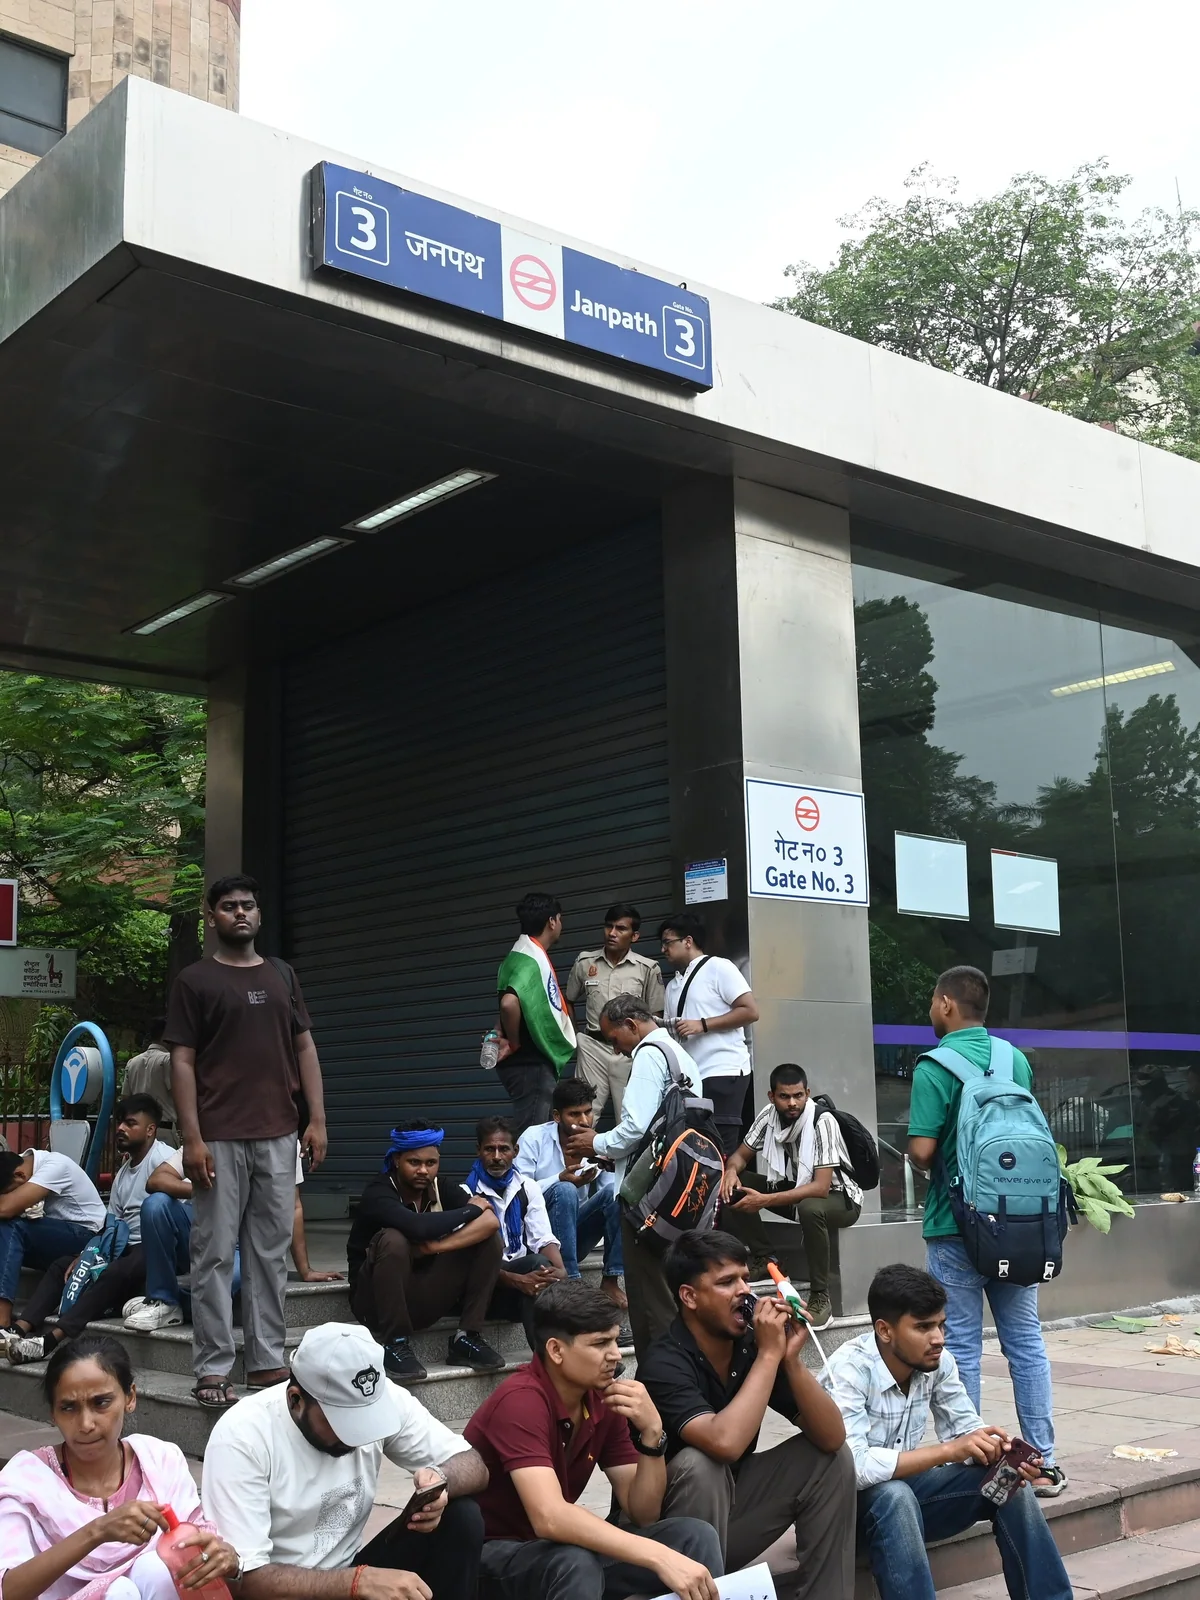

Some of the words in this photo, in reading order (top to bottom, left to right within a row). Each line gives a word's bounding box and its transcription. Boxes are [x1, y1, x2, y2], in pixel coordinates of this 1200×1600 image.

[352, 185, 363, 197] गेट
[350, 206, 377, 251] 3
[404, 230, 485, 280] जनपथ
[570, 289, 658, 338] Janpath
[672, 301, 684, 311] Gate
[685, 305, 694, 314] No.
[674, 318, 695, 358] 3
[774, 830, 799, 861] गेट
[833, 846, 843, 866] 3
[765, 865, 807, 890] Gate
[812, 870, 840, 893] No.
[844, 873, 855, 894] 3
[993, 1176, 1022, 1184] never
[1023, 1177, 1041, 1185] give
[1042, 1177, 1052, 1185] up
[66, 1259, 91, 1301] safari
